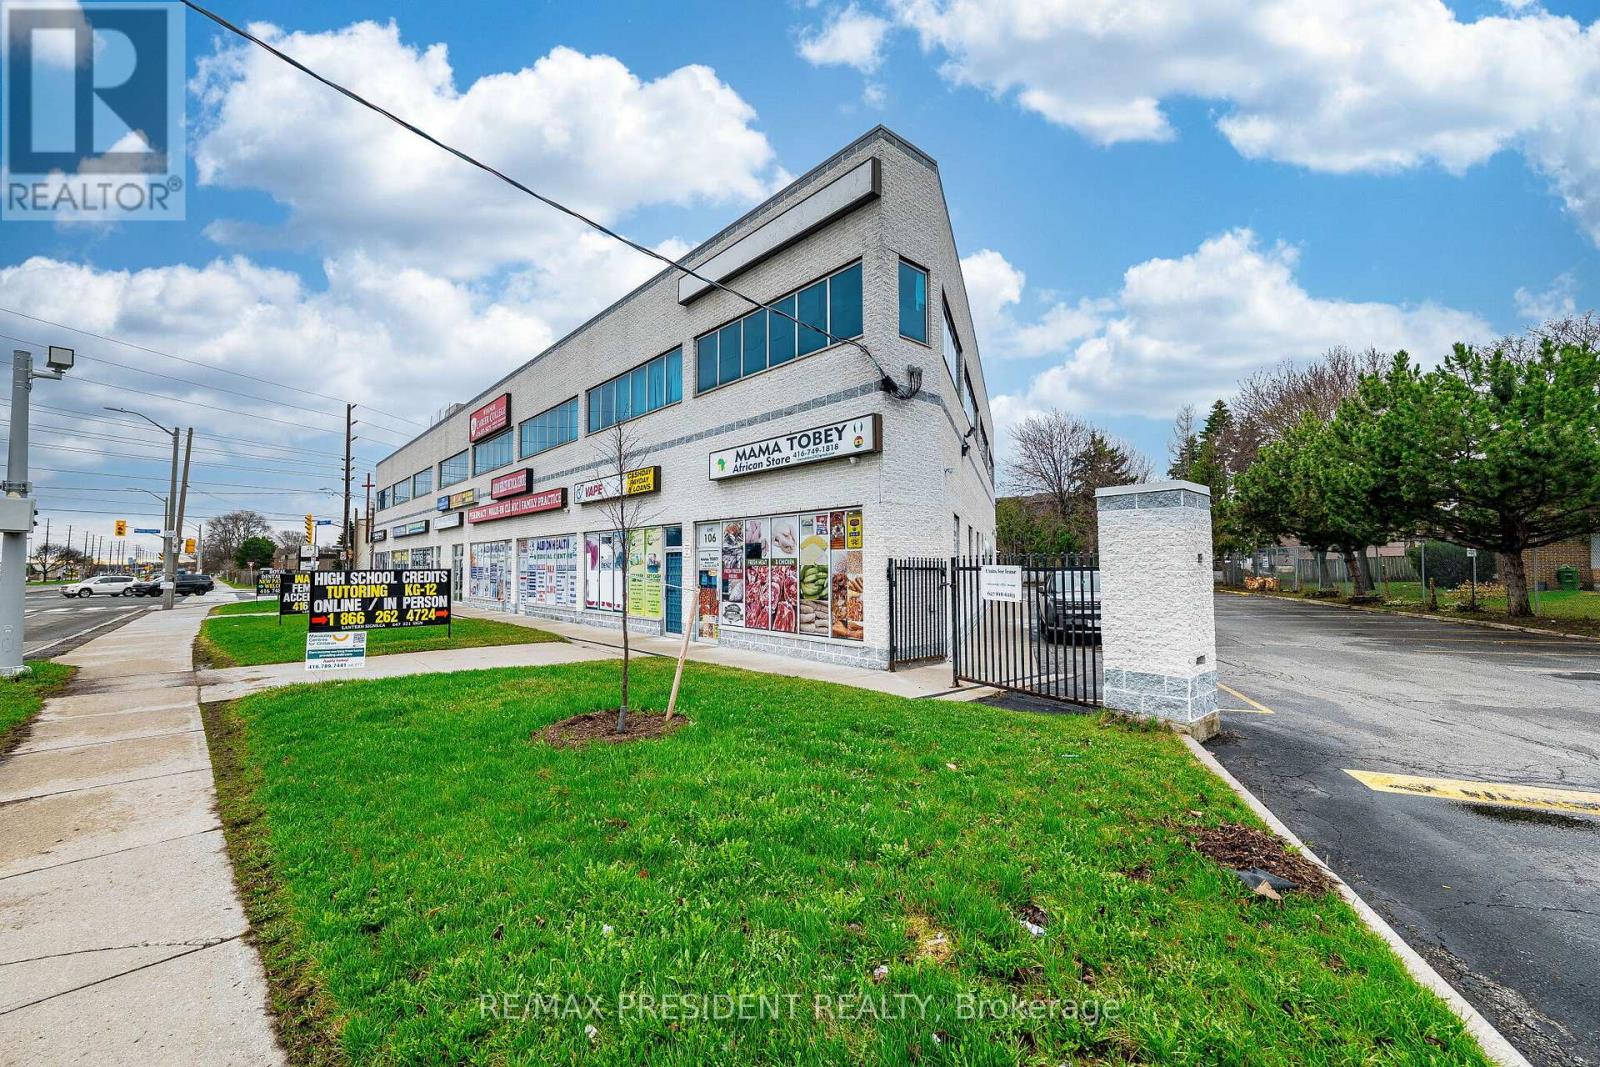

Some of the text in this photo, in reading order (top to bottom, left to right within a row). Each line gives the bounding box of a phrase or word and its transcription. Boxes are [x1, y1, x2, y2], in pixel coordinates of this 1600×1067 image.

[735, 441, 782, 463] MAMA
[787, 424, 848, 451] TOBEY
[792, 443, 839, 459] 416-749-1818
[732, 456, 791, 474] African Store
[585, 483, 604, 498] VAPE
[633, 484, 651, 493] LOANS
[521, 497, 538, 510] FAMILY
[538, 493, 562, 507] PRACTICE
[704, 533, 717, 543] 106
[314, 570, 448, 586] HIGH SCHOOL CREDITS
[326, 583, 437, 599] TUTORING KG-12
[292, 602, 309, 611] 416
[313, 598, 362, 613] ONLINE
[383, 597, 397, 610] IN
[402, 595, 448, 609] PERSON
[327, 608, 436, 626] 1 866 262 4724
